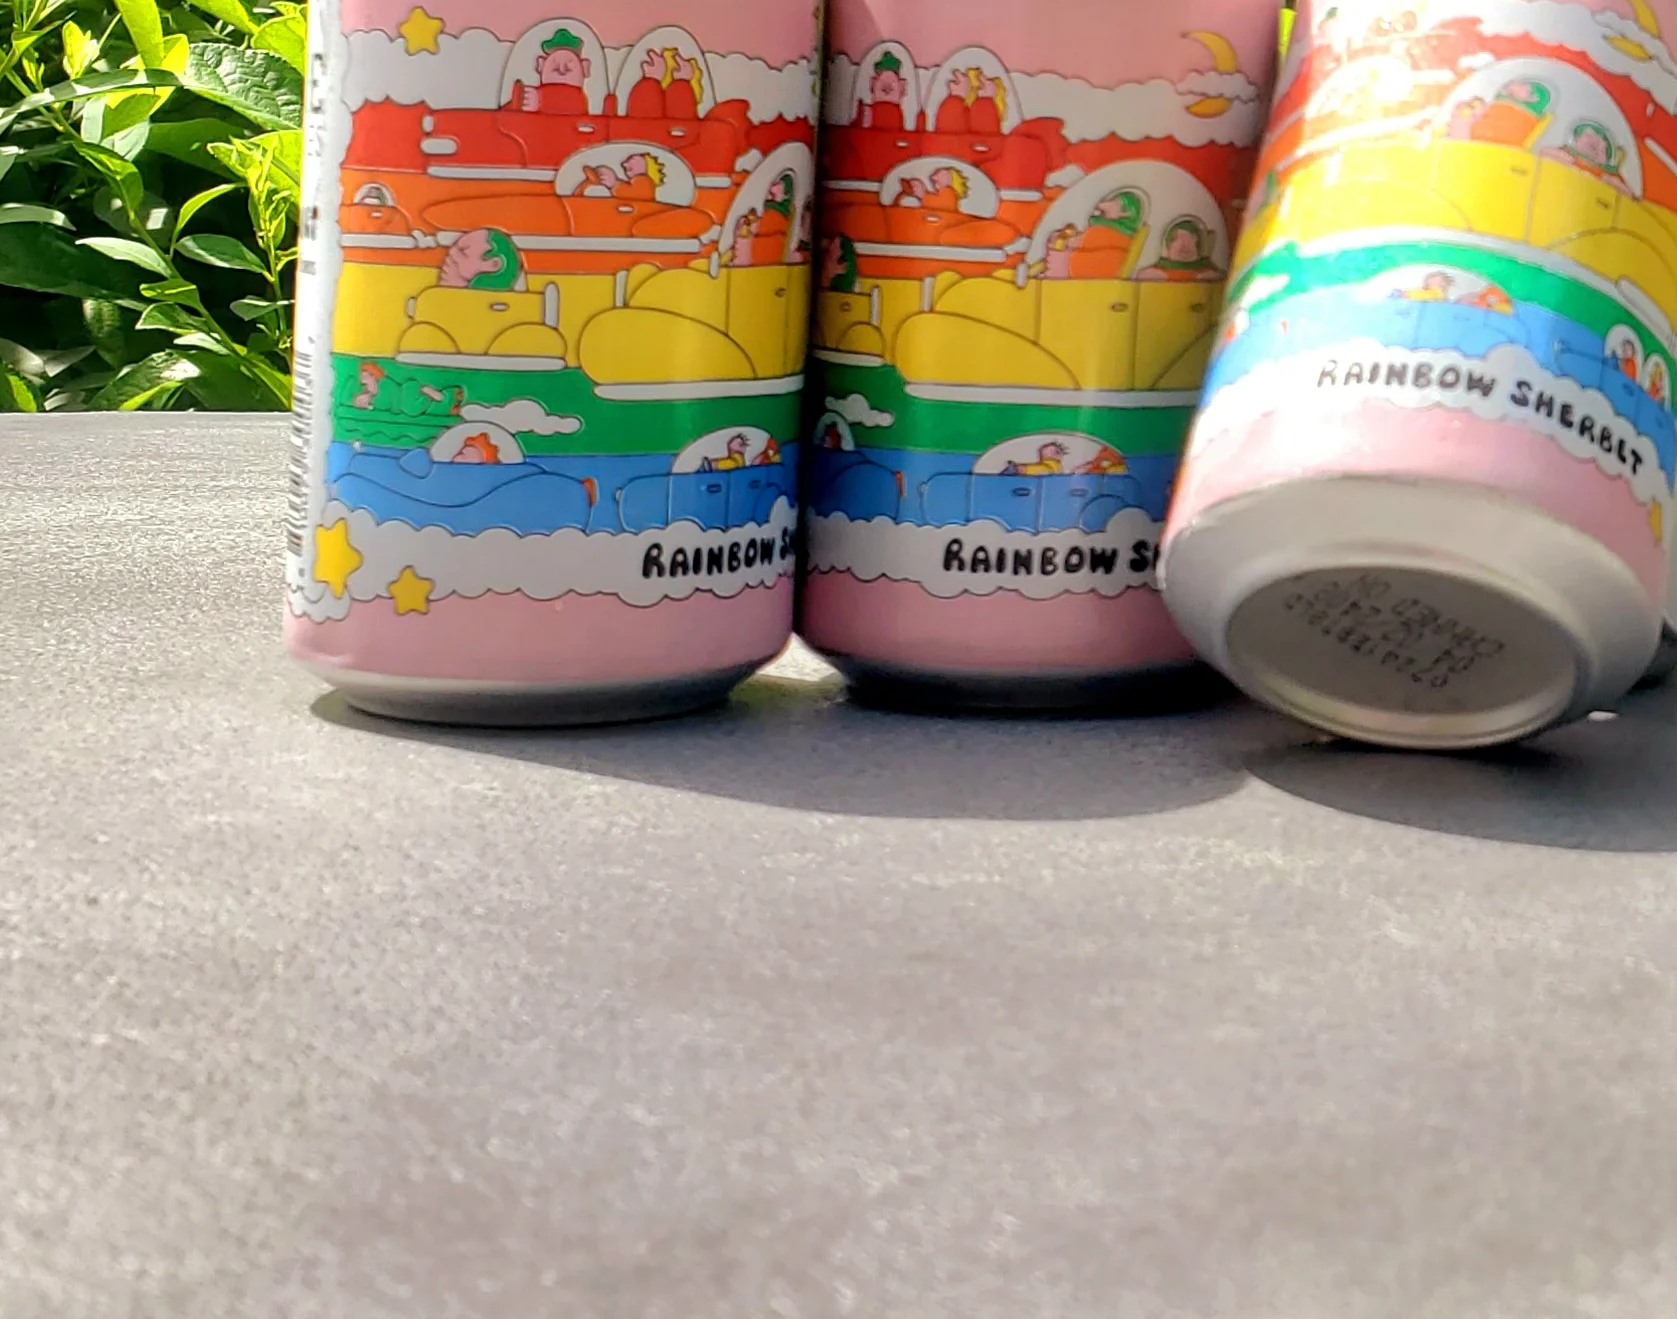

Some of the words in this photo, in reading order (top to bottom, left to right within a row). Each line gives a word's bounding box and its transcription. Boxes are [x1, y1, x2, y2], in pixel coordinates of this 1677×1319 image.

[1316, 358, 1498, 398] RAINBOW
[1510, 379, 1644, 476] SHERBET
[642, 537, 777, 579] RAINBOW
[943, 538, 1118, 576] RAINBOW
